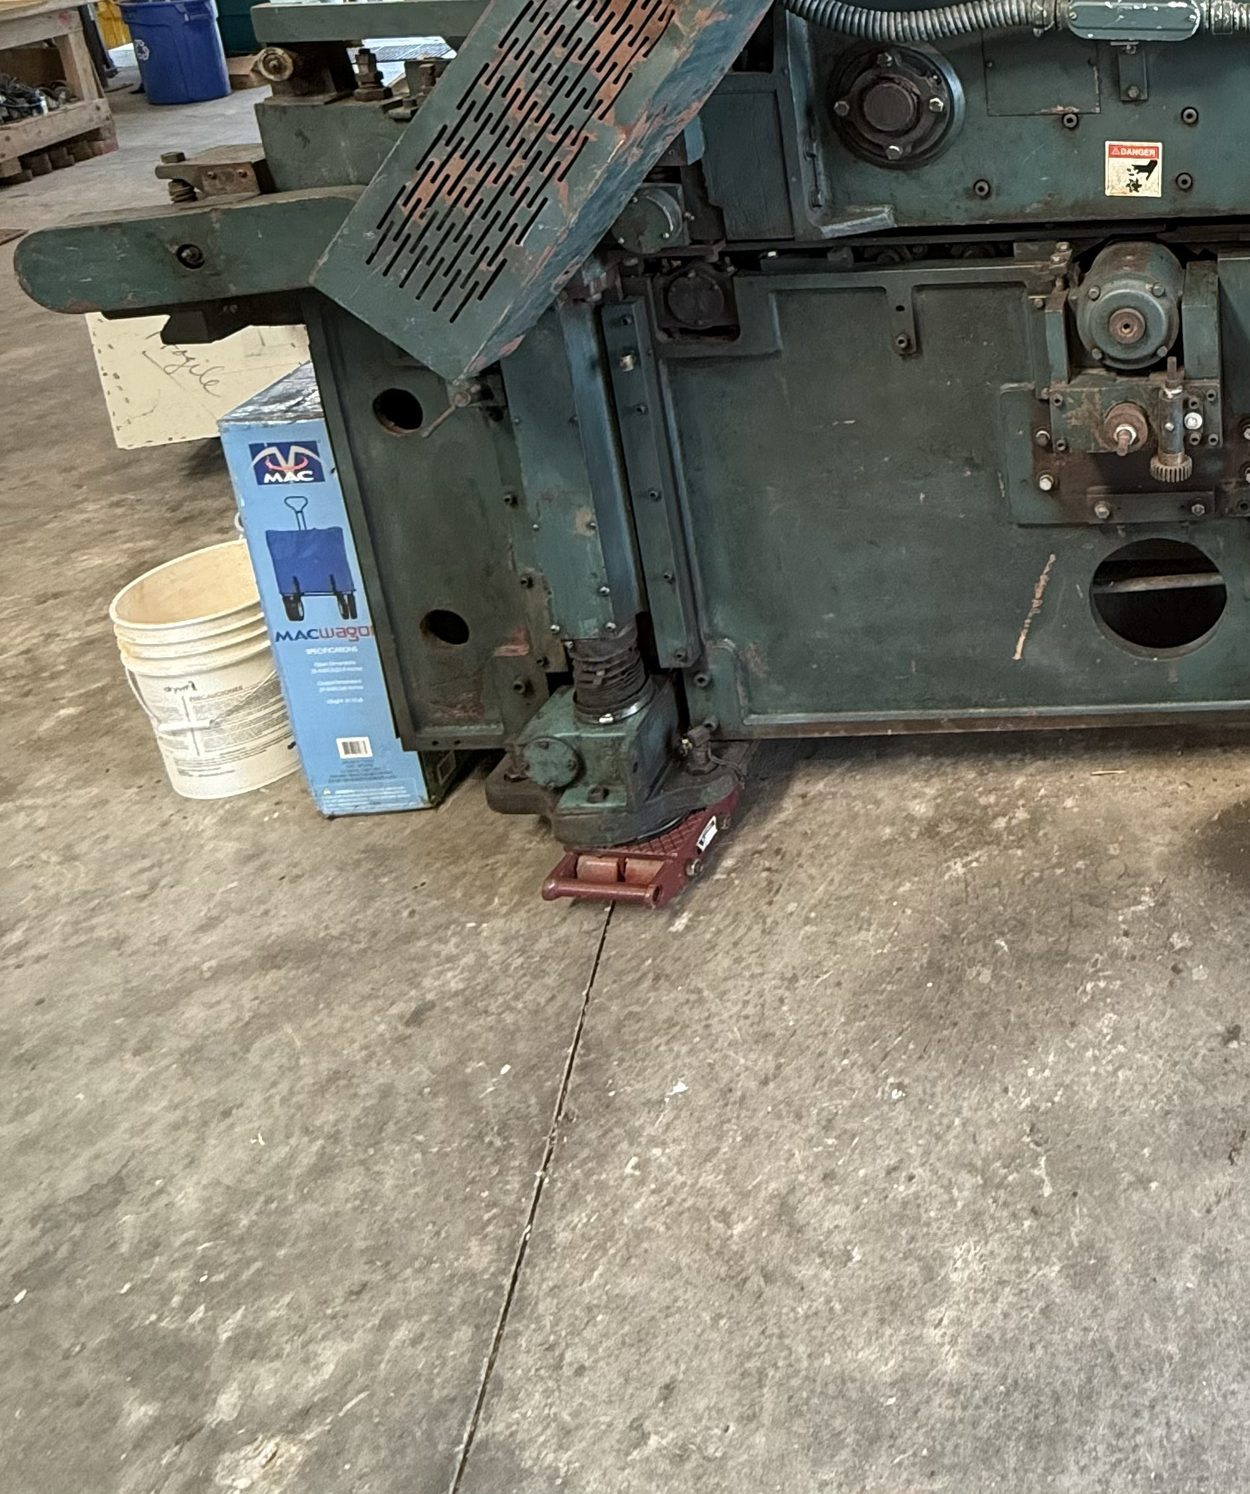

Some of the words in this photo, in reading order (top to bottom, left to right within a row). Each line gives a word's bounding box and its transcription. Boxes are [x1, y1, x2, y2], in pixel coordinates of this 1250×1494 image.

[1120, 147, 1156, 157] DANGER
[263, 470, 315, 484] MAC
[275, 625, 375, 643] MACwago
